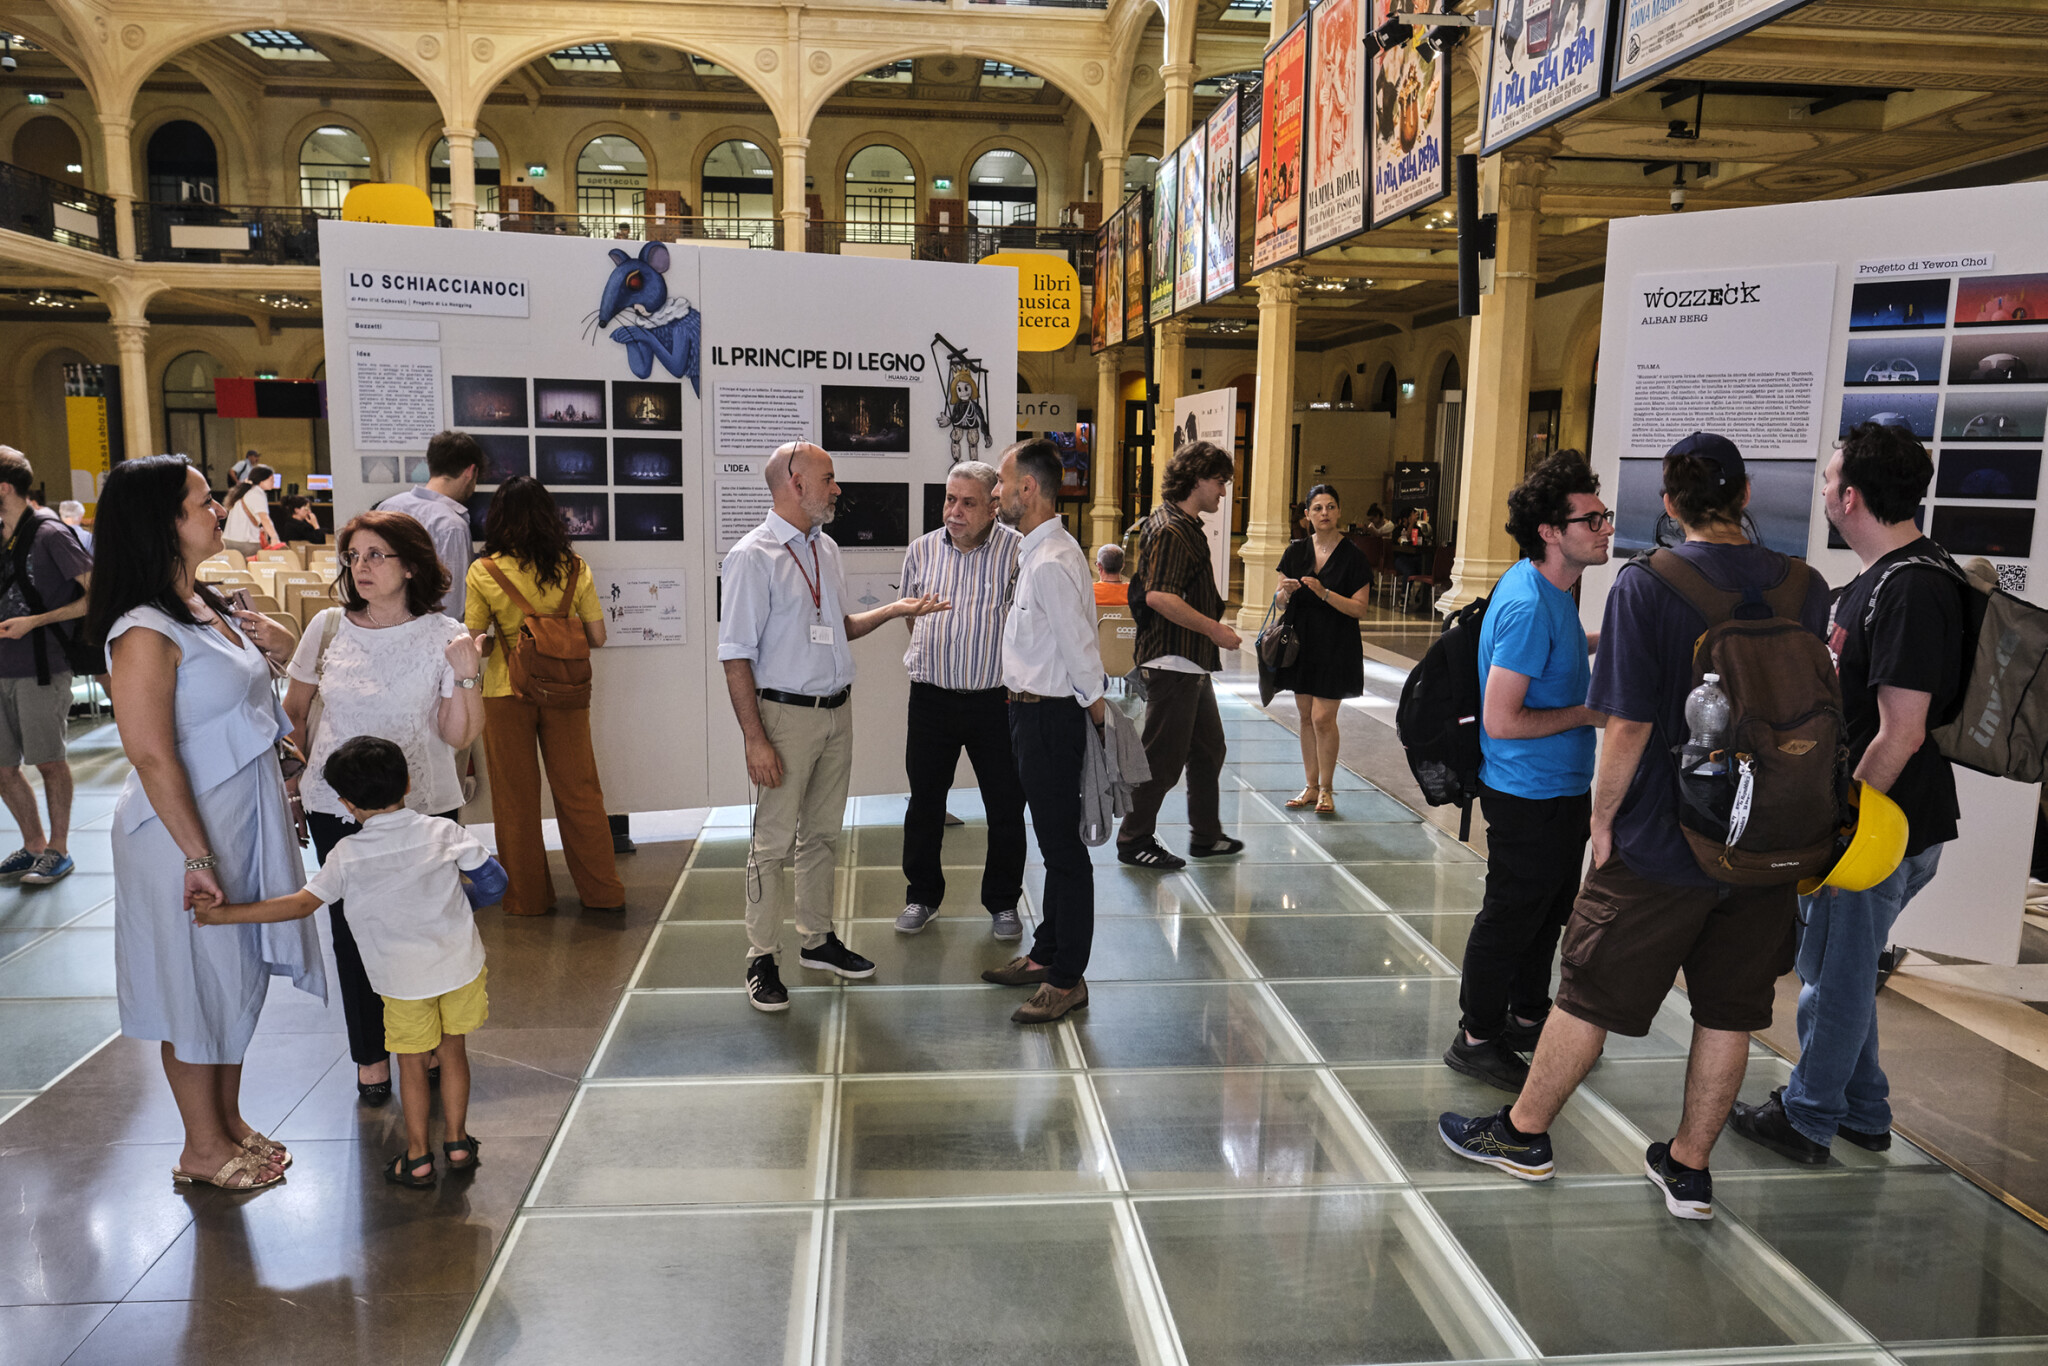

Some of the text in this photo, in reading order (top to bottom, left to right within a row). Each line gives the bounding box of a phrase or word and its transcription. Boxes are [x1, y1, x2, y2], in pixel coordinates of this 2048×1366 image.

[1629, 4, 1651, 32] ANNA
[1529, 49, 1560, 99] DELLA
[1561, 26, 1595, 81] PEPPA
[1398, 150, 1418, 187] DELLA
[1418, 135, 1440, 176] PEPPA
[587, 177, 640, 186] spettacolo
[868, 186, 894, 194] video
[1309, 182, 1335, 209] MAMMA
[1336, 168, 1361, 197] ROMA
[1337, 193, 1361, 214] PASOLINI
[1859, 257, 1987, 274] Progetto di Yewon Choi
[350, 272, 525, 297] LO SCHIACCIANOCI
[1033, 274, 1070, 291] libri
[1018, 294, 1071, 310] usica
[1644, 282, 1760, 309] WOZZECK
[355, 322, 382, 330] Bozzetti
[1018, 311, 1070, 328] icerca
[1641, 314, 1708, 325] ALBAN BERG
[712, 346, 925, 372] IL PRINCIPE DI LEGNO
[1016, 401, 1060, 415] info
[723, 463, 750, 472] L'IDEA
